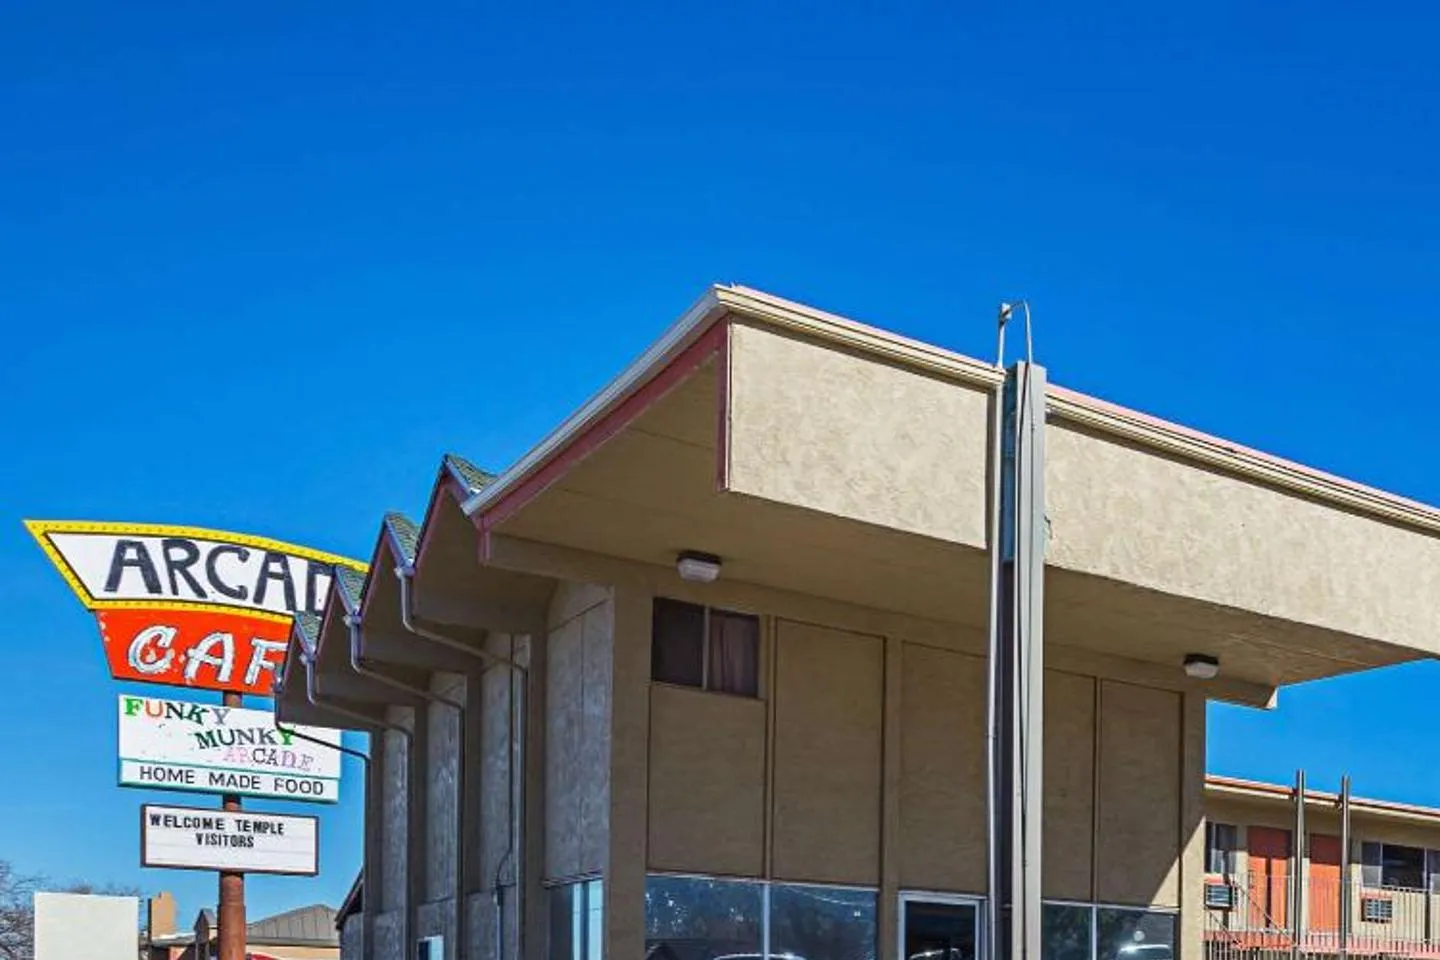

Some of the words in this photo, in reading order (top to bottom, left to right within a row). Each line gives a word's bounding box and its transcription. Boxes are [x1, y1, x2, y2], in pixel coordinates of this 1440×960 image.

[124, 697, 230, 725] FUNKY
[194, 727, 295, 750] MUNKY
[223, 746, 314, 772] ARCADE
[140, 766, 195, 784] HOME
[209, 772, 260, 790] MADE
[274, 778, 324, 795] FOOD
[150, 813, 226, 831] WELCOME
[235, 819, 285, 836] TEMPLE
[195, 832, 254, 848] VISITORS
